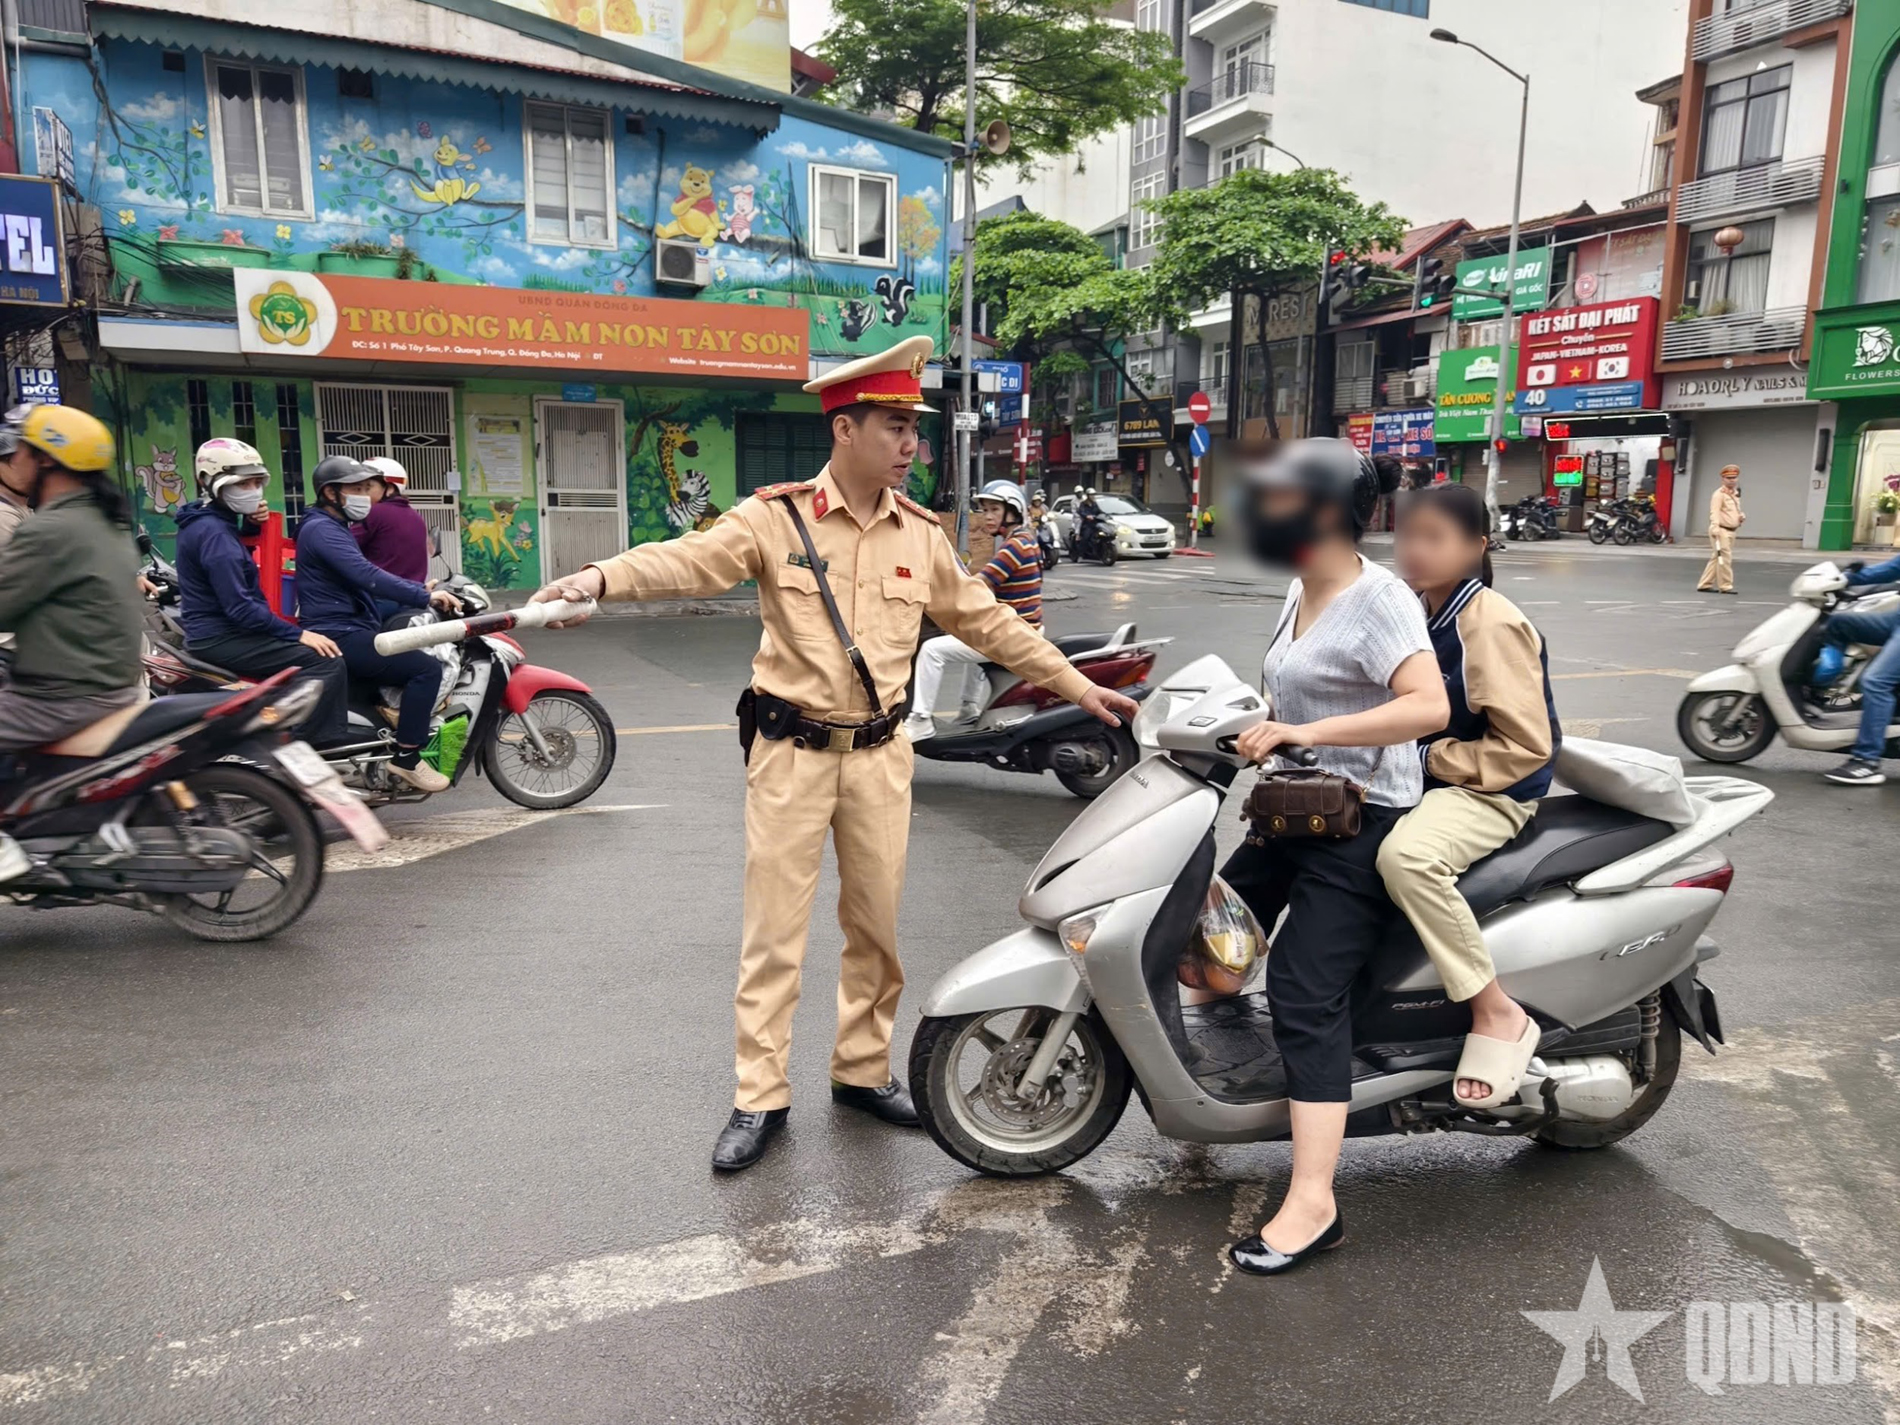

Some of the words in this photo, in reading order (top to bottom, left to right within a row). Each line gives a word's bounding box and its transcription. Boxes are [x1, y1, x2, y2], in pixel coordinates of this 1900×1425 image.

[518, 295, 552, 306] UBND
[272, 311, 295, 324] TS
[1552, 309, 1578, 333] SẮT
[1578, 311, 1602, 331] ĐẠI
[1604, 303, 1641, 326] PHÁT
[341, 303, 500, 340] TRƯỜNG
[507, 311, 591, 345] MẦM
[598, 321, 669, 350] NON
[677, 323, 737, 353] TÂY
[740, 330, 801, 355] SƠN
[382, 342, 387, 350] 1
[408, 343, 424, 353] Tây
[454, 346, 482, 356] Quang
[668, 357, 697, 366] Website
[20, 368, 58, 385] HO
[1845, 369, 1900, 380] FLOWERS
[1524, 389, 1546, 405] 40
